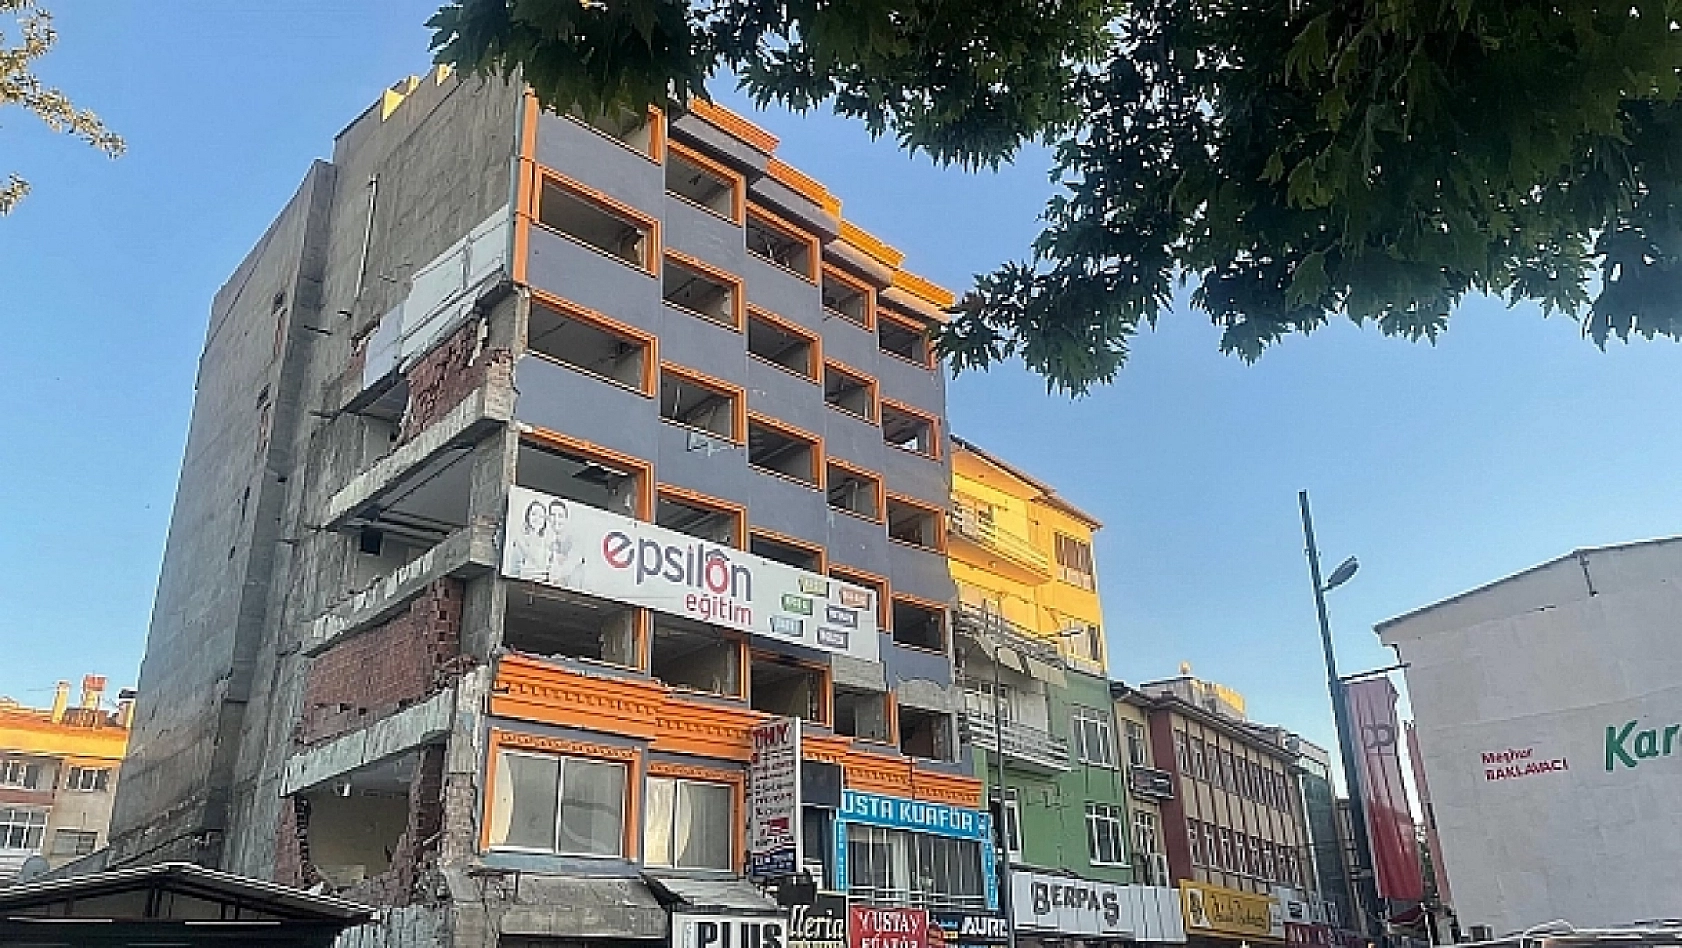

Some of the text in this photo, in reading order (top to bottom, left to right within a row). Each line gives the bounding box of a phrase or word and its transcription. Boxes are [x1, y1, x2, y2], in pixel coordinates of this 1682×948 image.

[686, 593, 751, 626] eğitim
[1605, 719, 1682, 773] Kar
[842, 790, 893, 821] USTA
